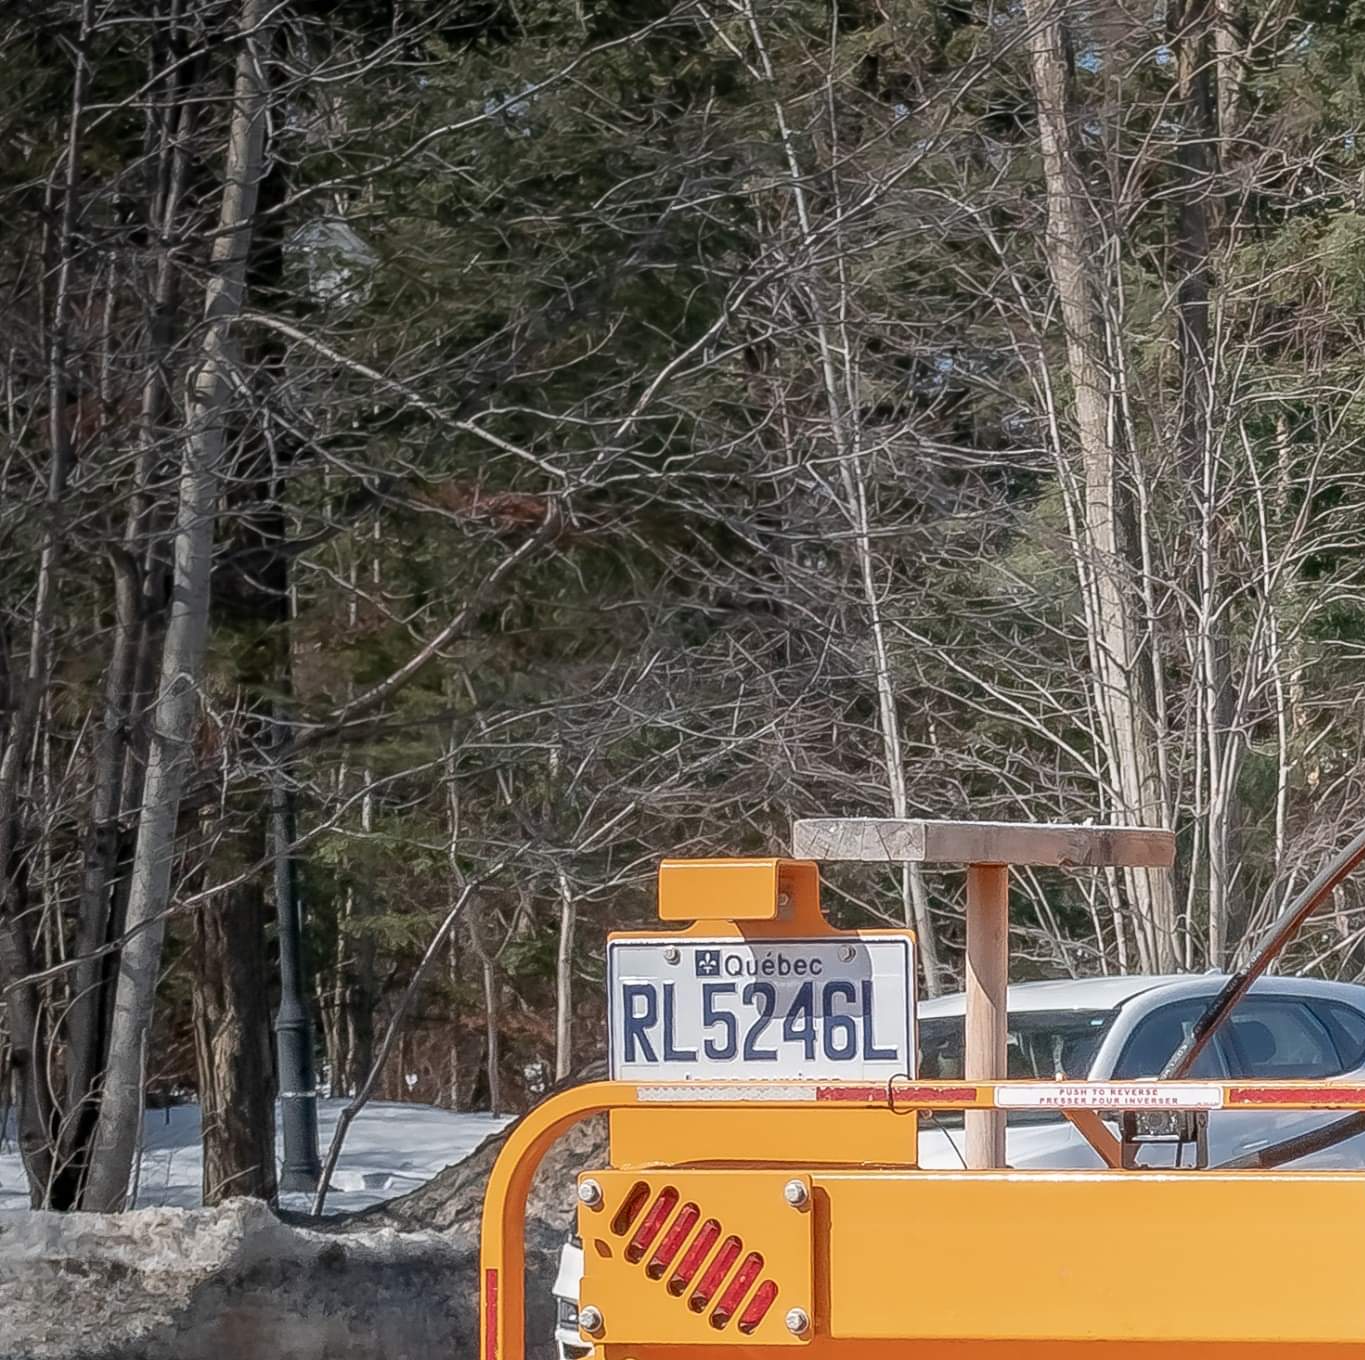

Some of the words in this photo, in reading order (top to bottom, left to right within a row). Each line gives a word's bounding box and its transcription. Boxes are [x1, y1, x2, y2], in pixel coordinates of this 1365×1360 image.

[723, 951, 823, 976] Québec
[622, 979, 899, 1063] RL5246L
[1058, 1088, 1088, 1096] PUSH
[1092, 1088, 1106, 1096] TO
[1110, 1088, 1158, 1096] REVERSE
[1039, 1097, 1088, 1105] PRESSER
[1091, 1097, 1120, 1105] POUR
[1124, 1097, 1179, 1105] INVERSER
